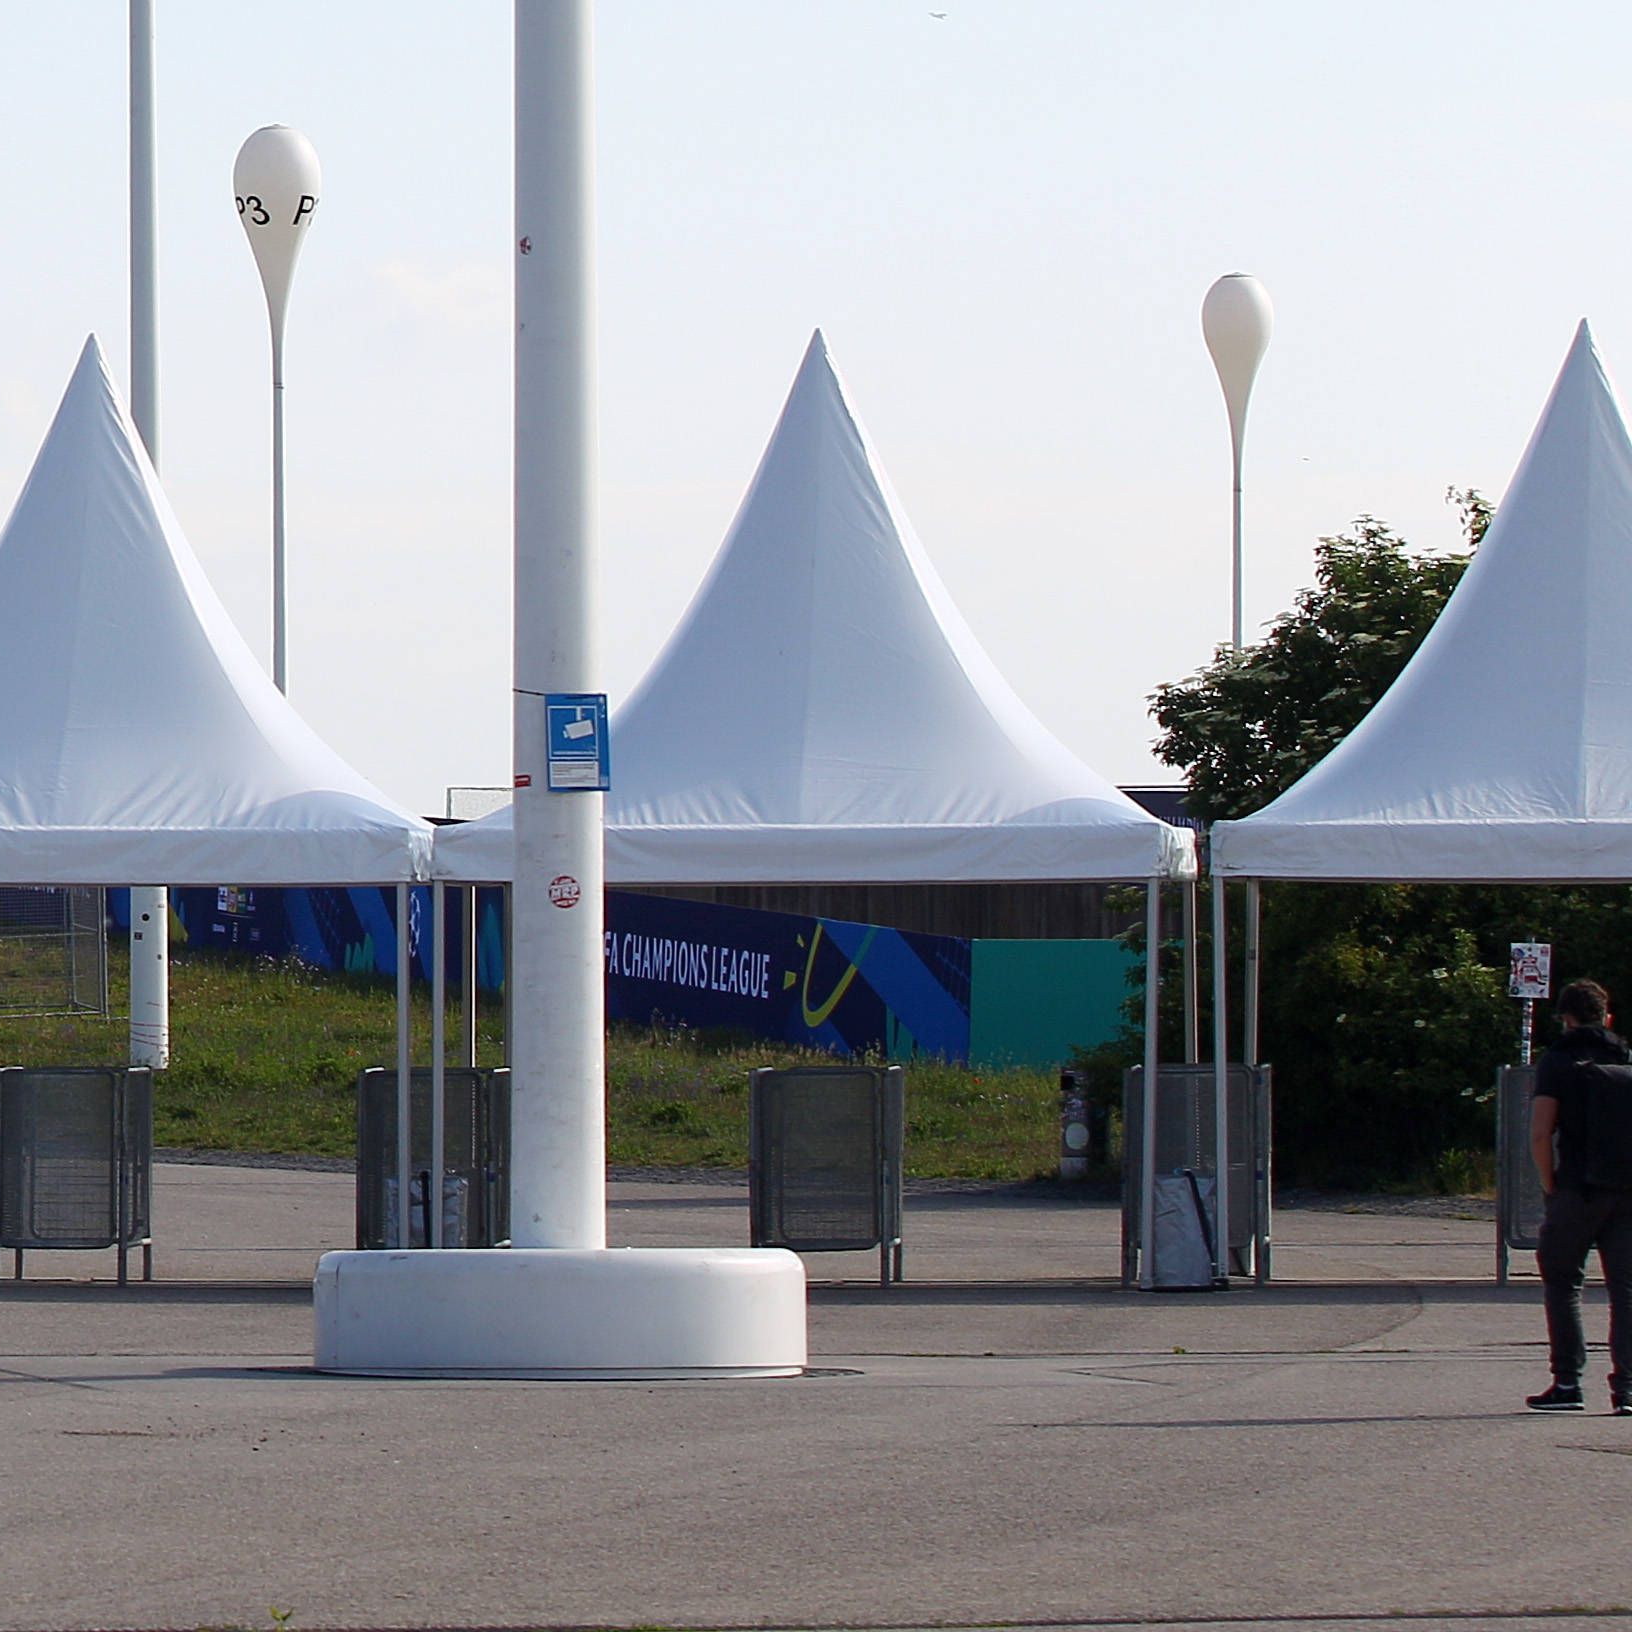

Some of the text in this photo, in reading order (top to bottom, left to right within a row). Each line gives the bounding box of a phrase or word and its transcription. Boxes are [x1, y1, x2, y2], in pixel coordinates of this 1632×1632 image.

[293, 195, 319, 226] P
[623, 933, 708, 989] CHAMPIONS
[711, 946, 771, 999] LEAGUE
